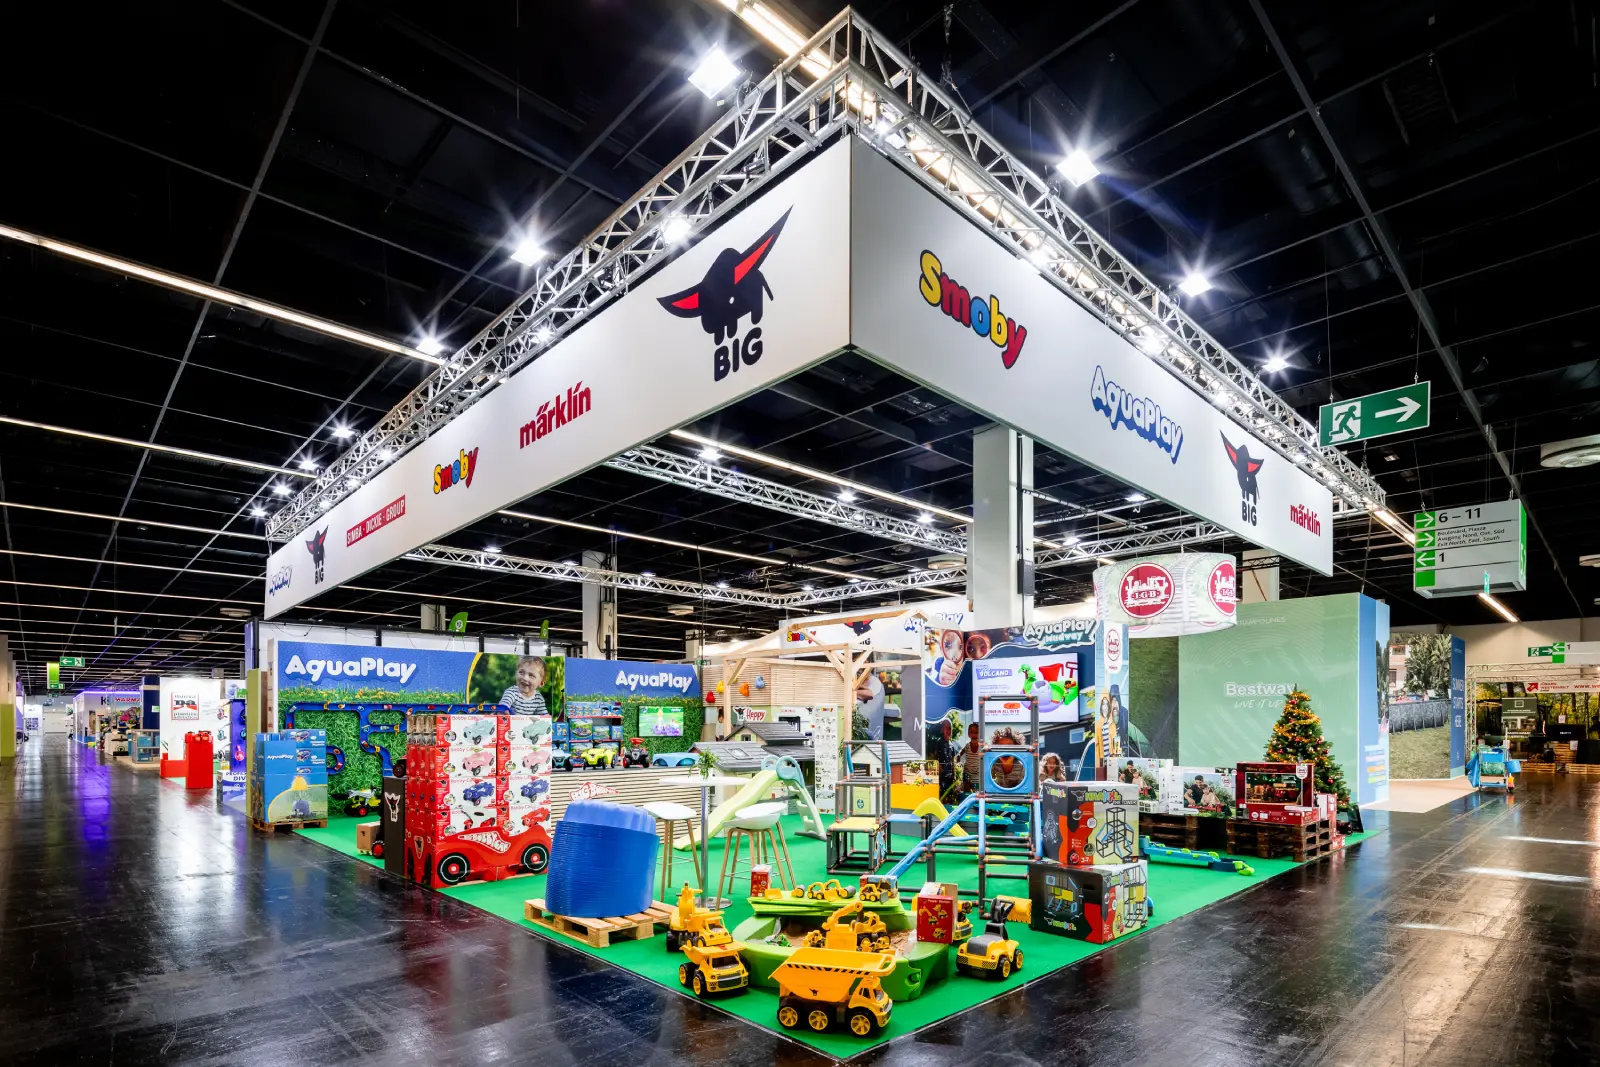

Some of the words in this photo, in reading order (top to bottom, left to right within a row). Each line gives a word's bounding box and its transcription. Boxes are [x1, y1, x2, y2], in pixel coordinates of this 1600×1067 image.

[919, 249, 1027, 370] Smoby
[714, 327, 763, 382] BIG
[1091, 365, 1184, 464] AquaPlay
[433, 446, 480, 494] Smoby
[347, 526, 363, 544] SIMBA
[365, 513, 382, 534] DICKIE
[386, 499, 405, 521] GROUP
[1241, 501, 1258, 527] BIG
[1438, 512, 1448, 523] 6
[1465, 507, 1482, 520] 11
[1437, 534, 1461, 542] Ausgang
[1438, 552, 1445, 563] 1
[315, 567, 324, 584] BIG
[1026, 618, 1096, 639] AquaPlay
[1045, 632, 1083, 643] Mudway
[285, 655, 418, 684] AquaPlay
[615, 670, 693, 693] AquaPlay
[746, 708, 766, 721] Heppy
[1234, 699, 1255, 709] LIVE
